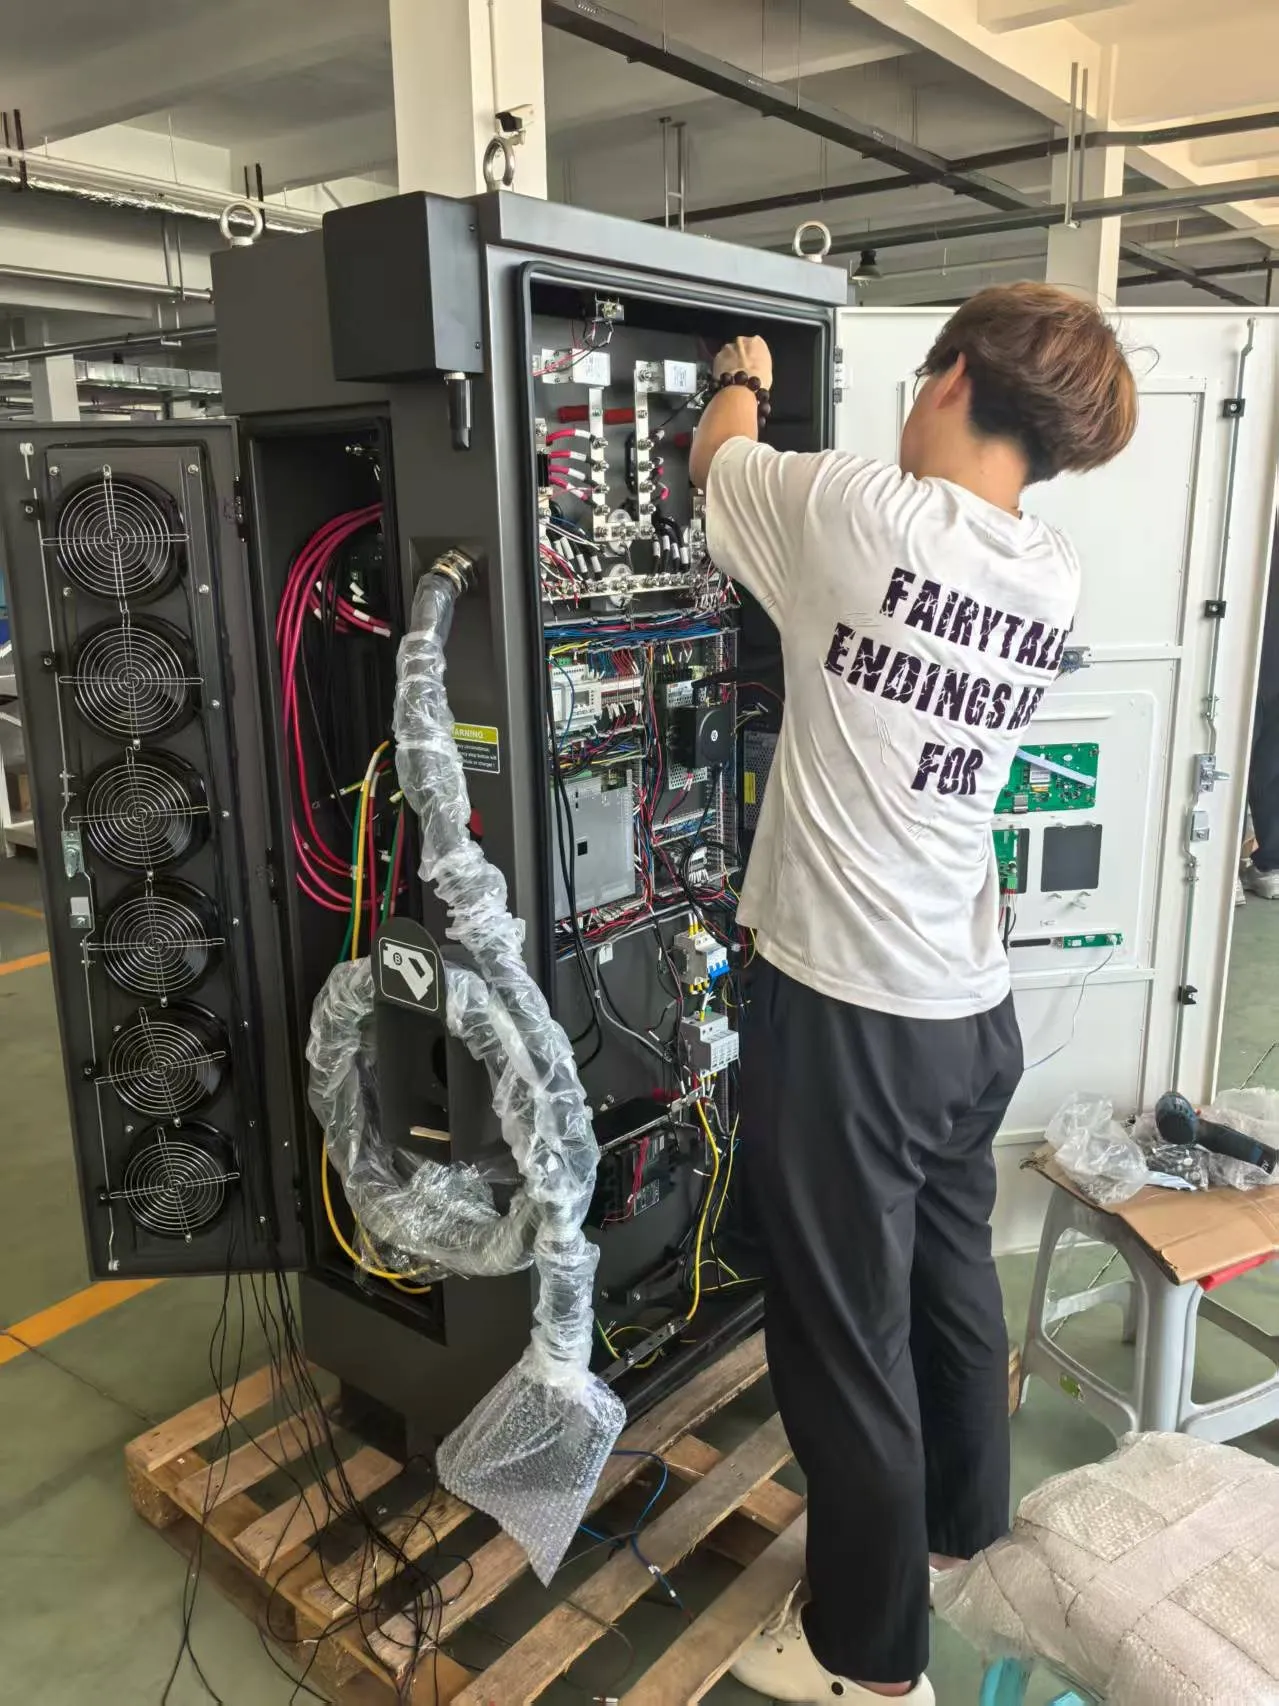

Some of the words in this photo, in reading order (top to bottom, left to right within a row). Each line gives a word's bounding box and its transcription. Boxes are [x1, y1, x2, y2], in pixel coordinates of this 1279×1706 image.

[824, 622, 1012, 730] ENDINGS
[452, 727, 484, 739] ARNING
[911, 742, 983, 795] FOR
